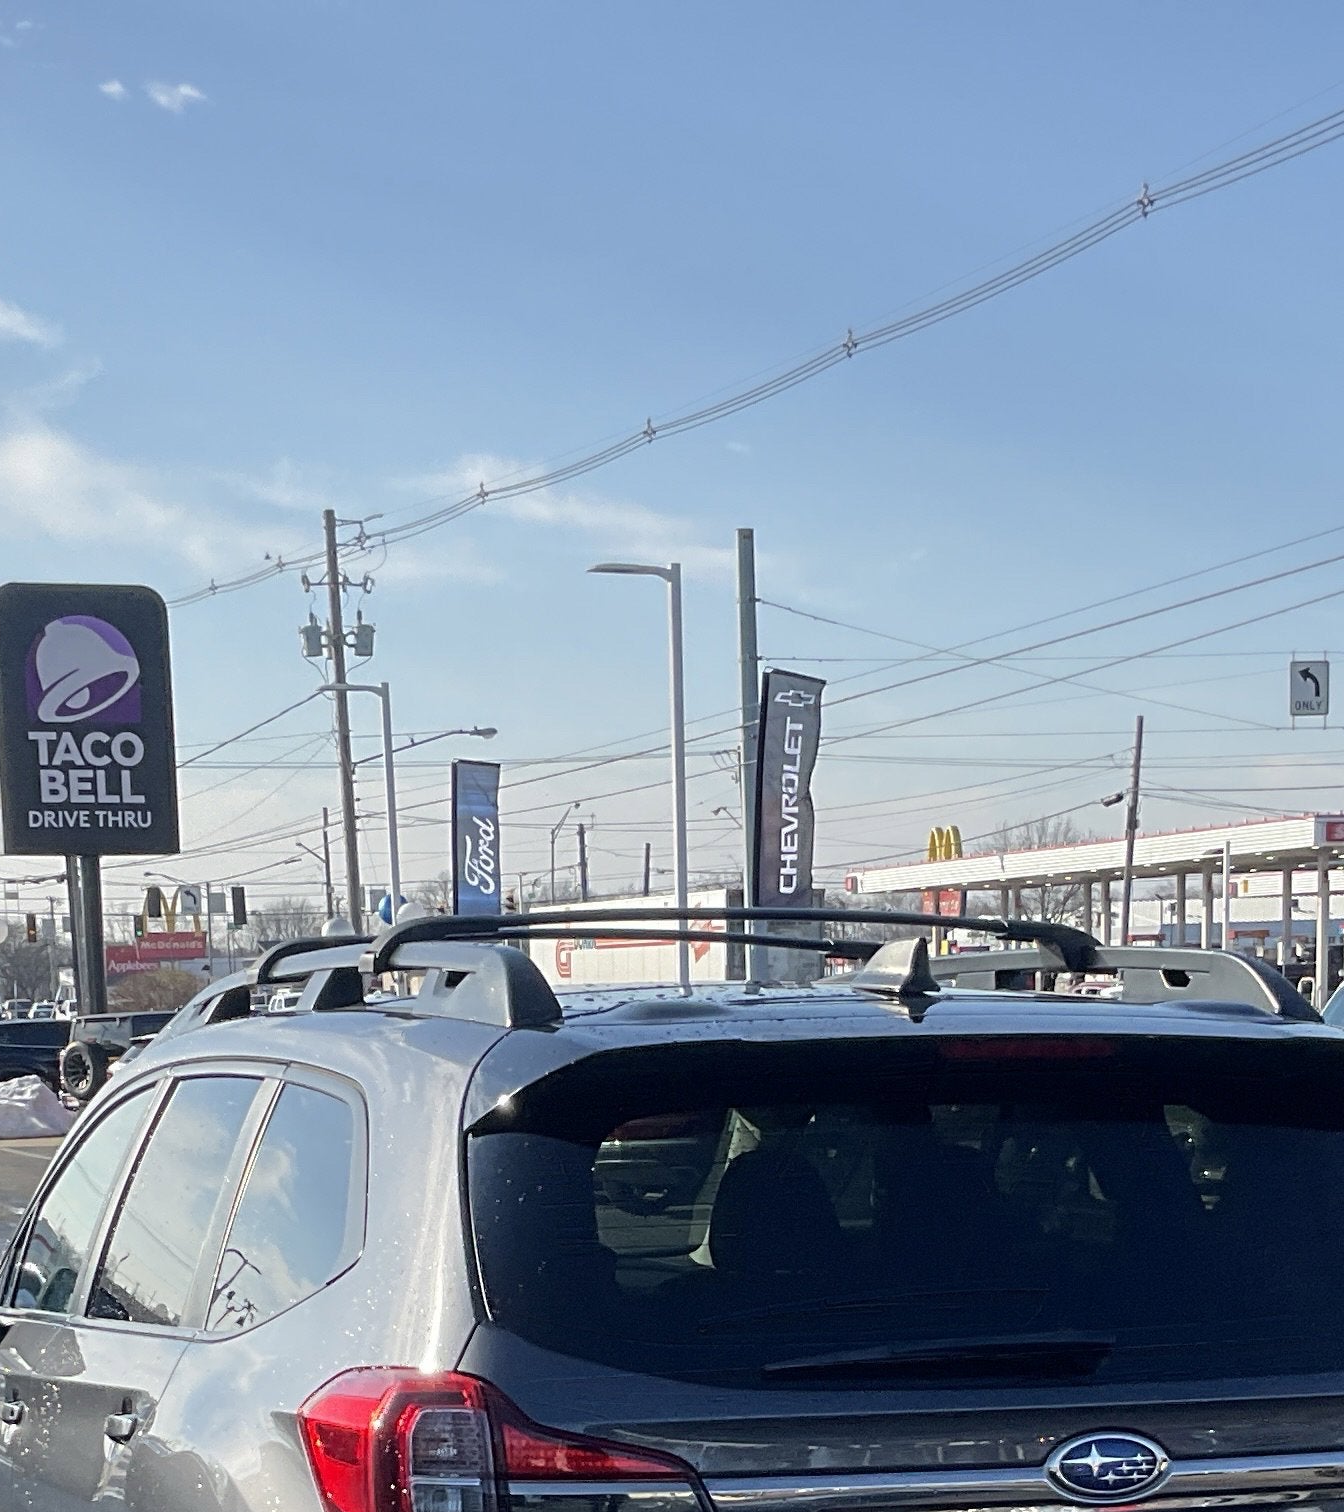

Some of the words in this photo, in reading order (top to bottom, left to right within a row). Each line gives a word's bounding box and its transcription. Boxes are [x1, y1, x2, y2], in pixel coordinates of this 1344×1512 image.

[1294, 701, 1322, 711] ONLY
[27, 731, 145, 767] TACO
[39, 769, 146, 804] BELL
[28, 810, 91, 828] DRIVE
[94, 810, 152, 828] THRU
[779, 716, 803, 894] CHEVROLET
[464, 816, 495, 895] Ford
[141, 940, 203, 950] McDonald's
